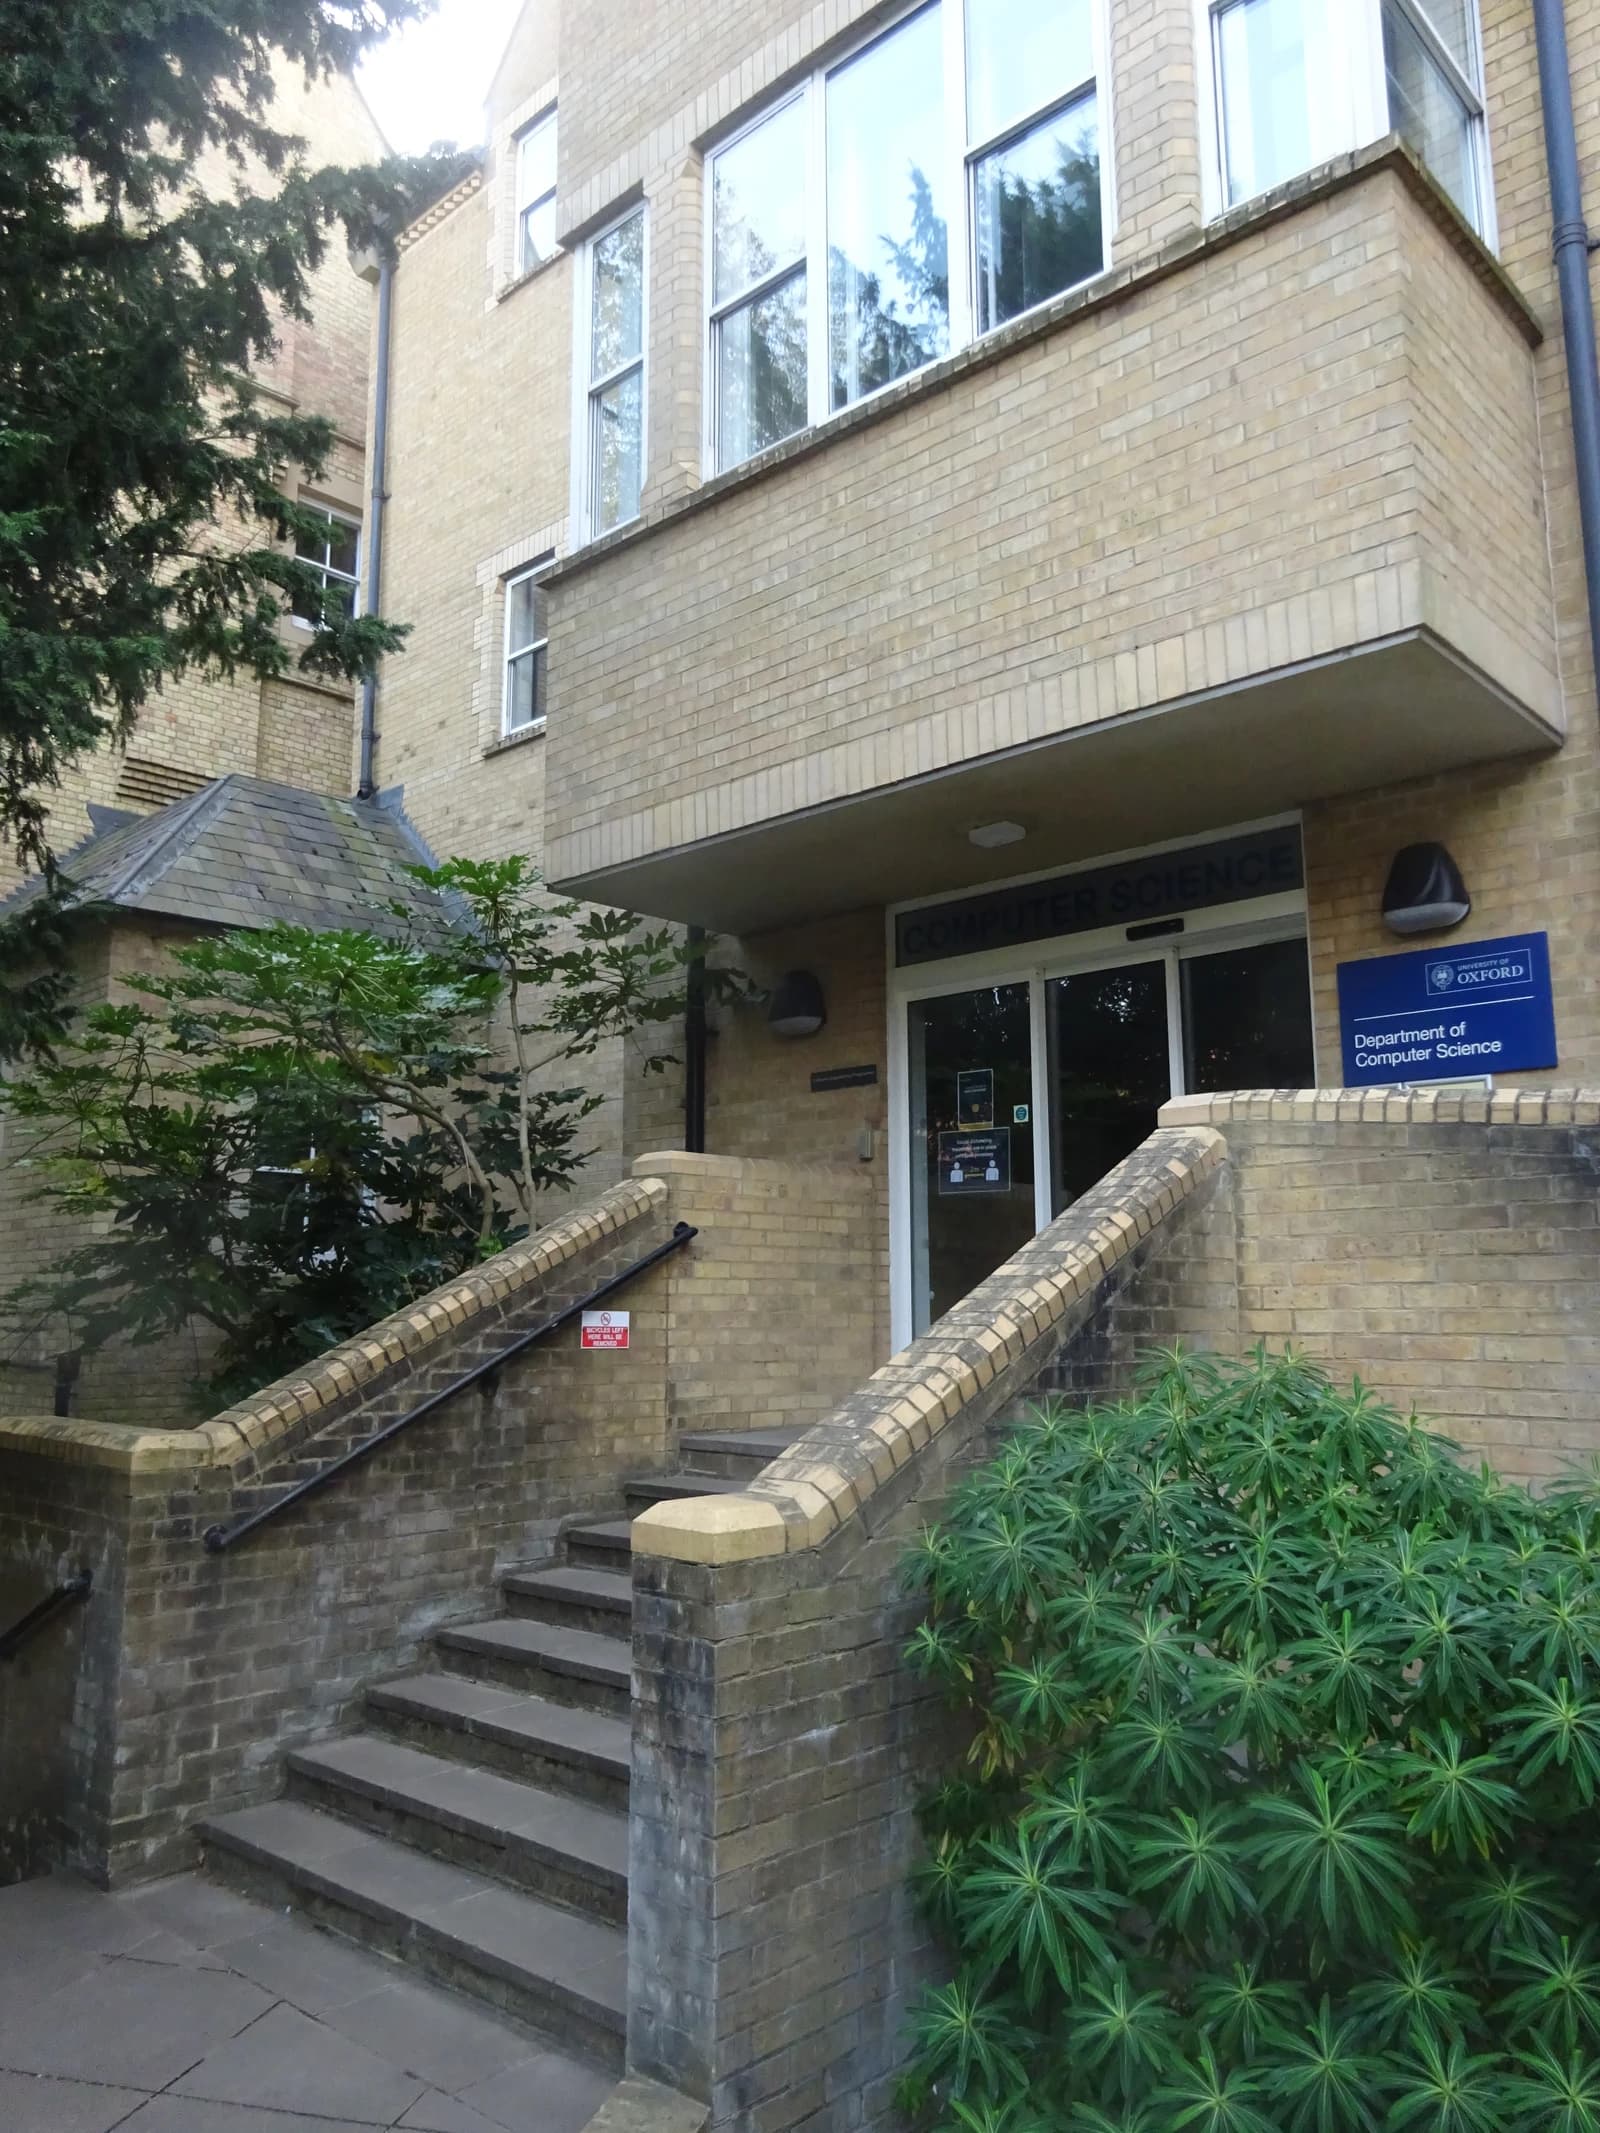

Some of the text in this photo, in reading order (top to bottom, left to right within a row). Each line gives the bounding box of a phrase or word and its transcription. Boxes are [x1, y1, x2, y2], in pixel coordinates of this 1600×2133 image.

[903, 845, 1295, 955] COMPUTER SCIENCE
[1457, 960, 1498, 971] UNIVERSITY
[1457, 965, 1524, 984] OXFORD
[1354, 1021, 1467, 1049] Department of
[1355, 1040, 1502, 1068] Computer Science
